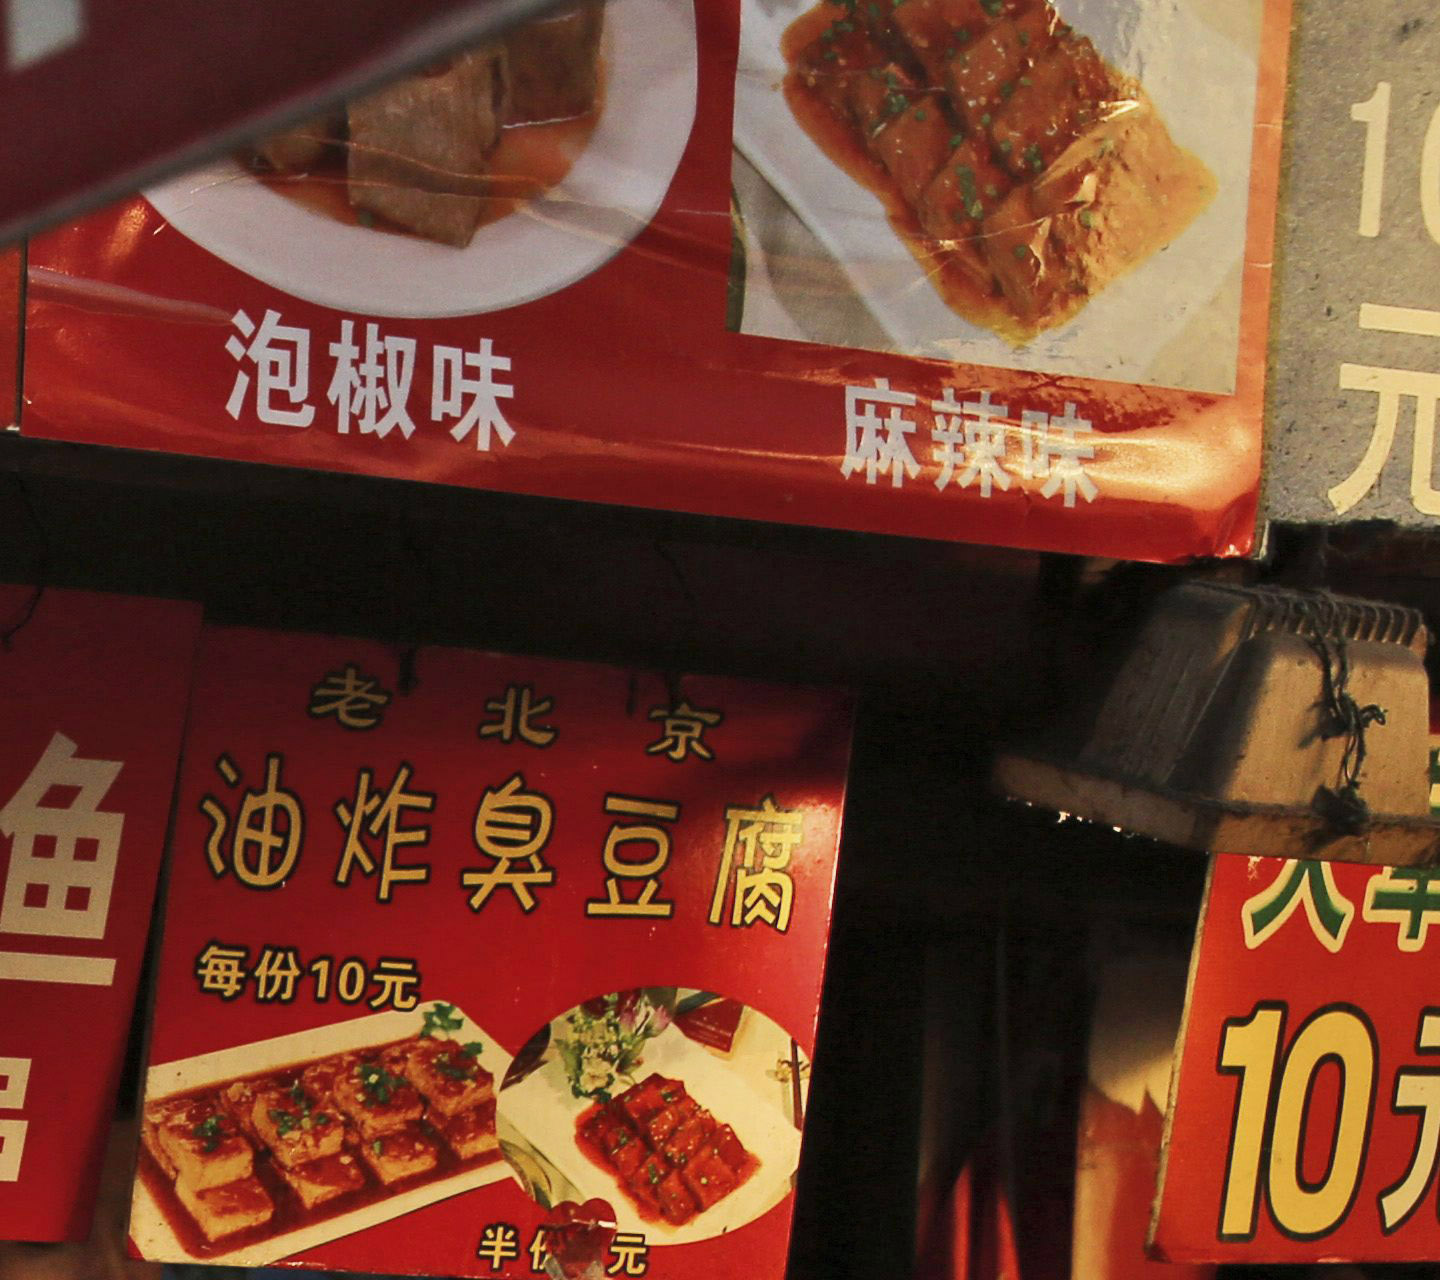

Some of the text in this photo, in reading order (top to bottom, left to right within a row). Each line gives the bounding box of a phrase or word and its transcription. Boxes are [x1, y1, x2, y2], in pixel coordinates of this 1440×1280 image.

[1350, 81, 1440, 246] 1
[223, 308, 518, 453] 泡椒味
[840, 377, 1099, 508] 麻辣味
[309, 666, 723, 762] 老北京
[199, 754, 805, 935] 油炸臭豆腐
[194, 945, 422, 1012] 每份10元
